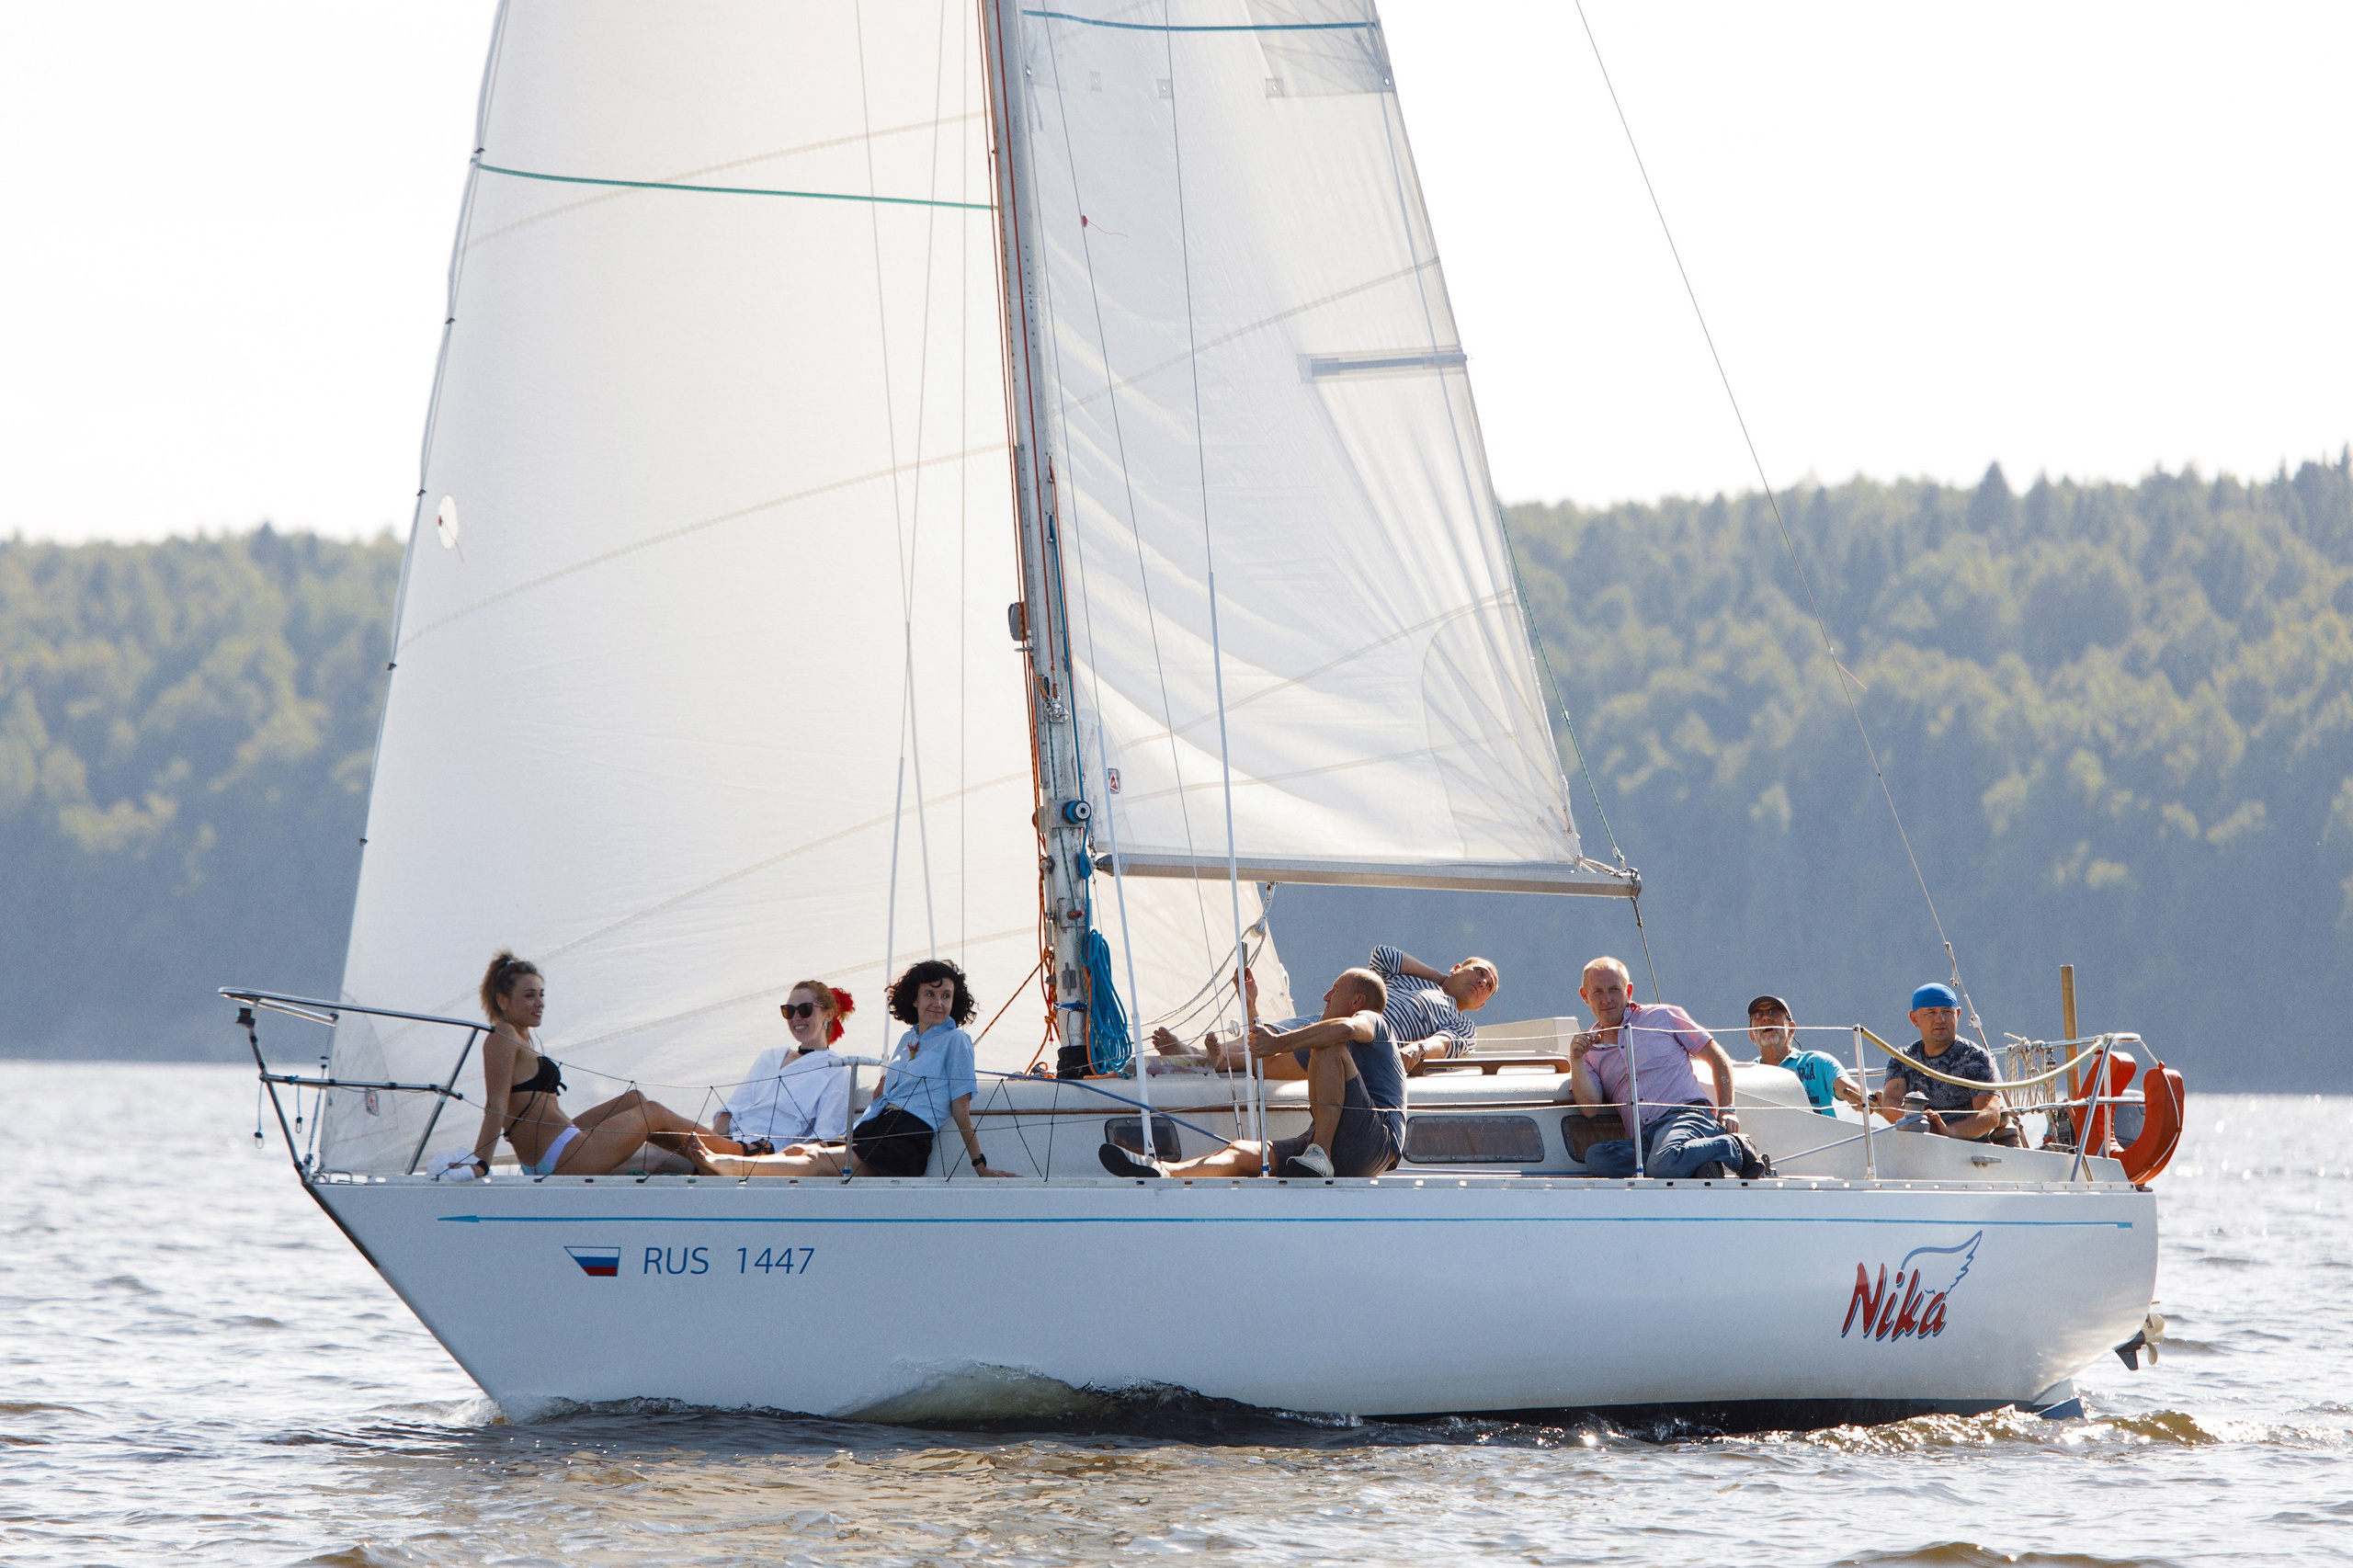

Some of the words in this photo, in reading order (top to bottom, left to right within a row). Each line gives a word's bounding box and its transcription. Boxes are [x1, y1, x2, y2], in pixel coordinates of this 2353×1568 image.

[643, 1246, 710, 1275] RUS
[736, 1246, 815, 1275] 1447
[1841, 1262, 1948, 1343] Nika
